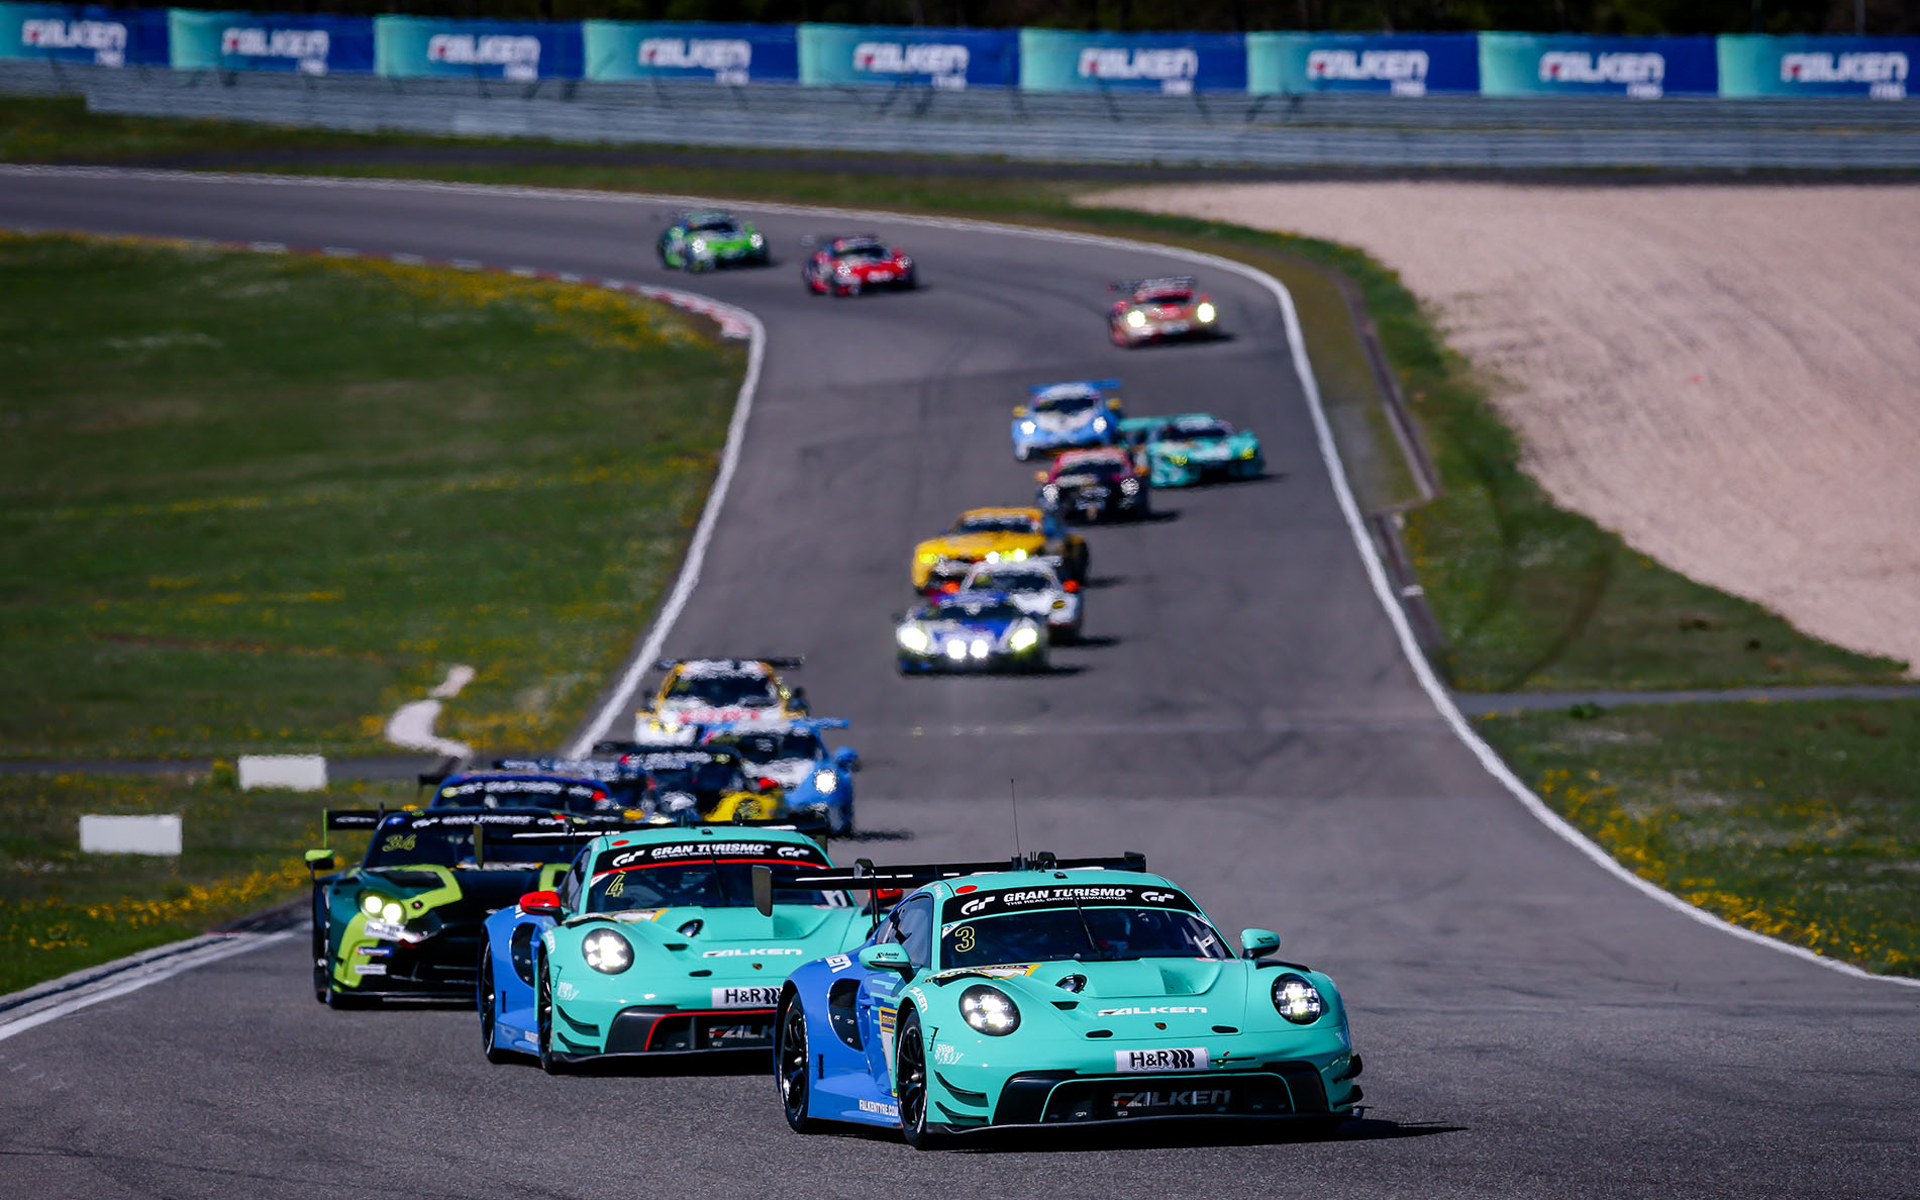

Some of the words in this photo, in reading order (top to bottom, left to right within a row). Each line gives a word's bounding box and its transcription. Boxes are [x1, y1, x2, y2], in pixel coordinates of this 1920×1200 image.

[651, 845, 693, 856] GRAN
[605, 870, 625, 898] 4
[1004, 890, 1050, 902] GRAN
[1053, 888, 1126, 897] TURISMO
[954, 926, 976, 952] 3
[703, 949, 803, 957] FALKEN
[725, 988, 760, 1004] H&R
[1098, 1006, 1208, 1016] FALKEN
[1131, 1051, 1170, 1068] H&R
[1113, 1091, 1231, 1107] FALKEN
